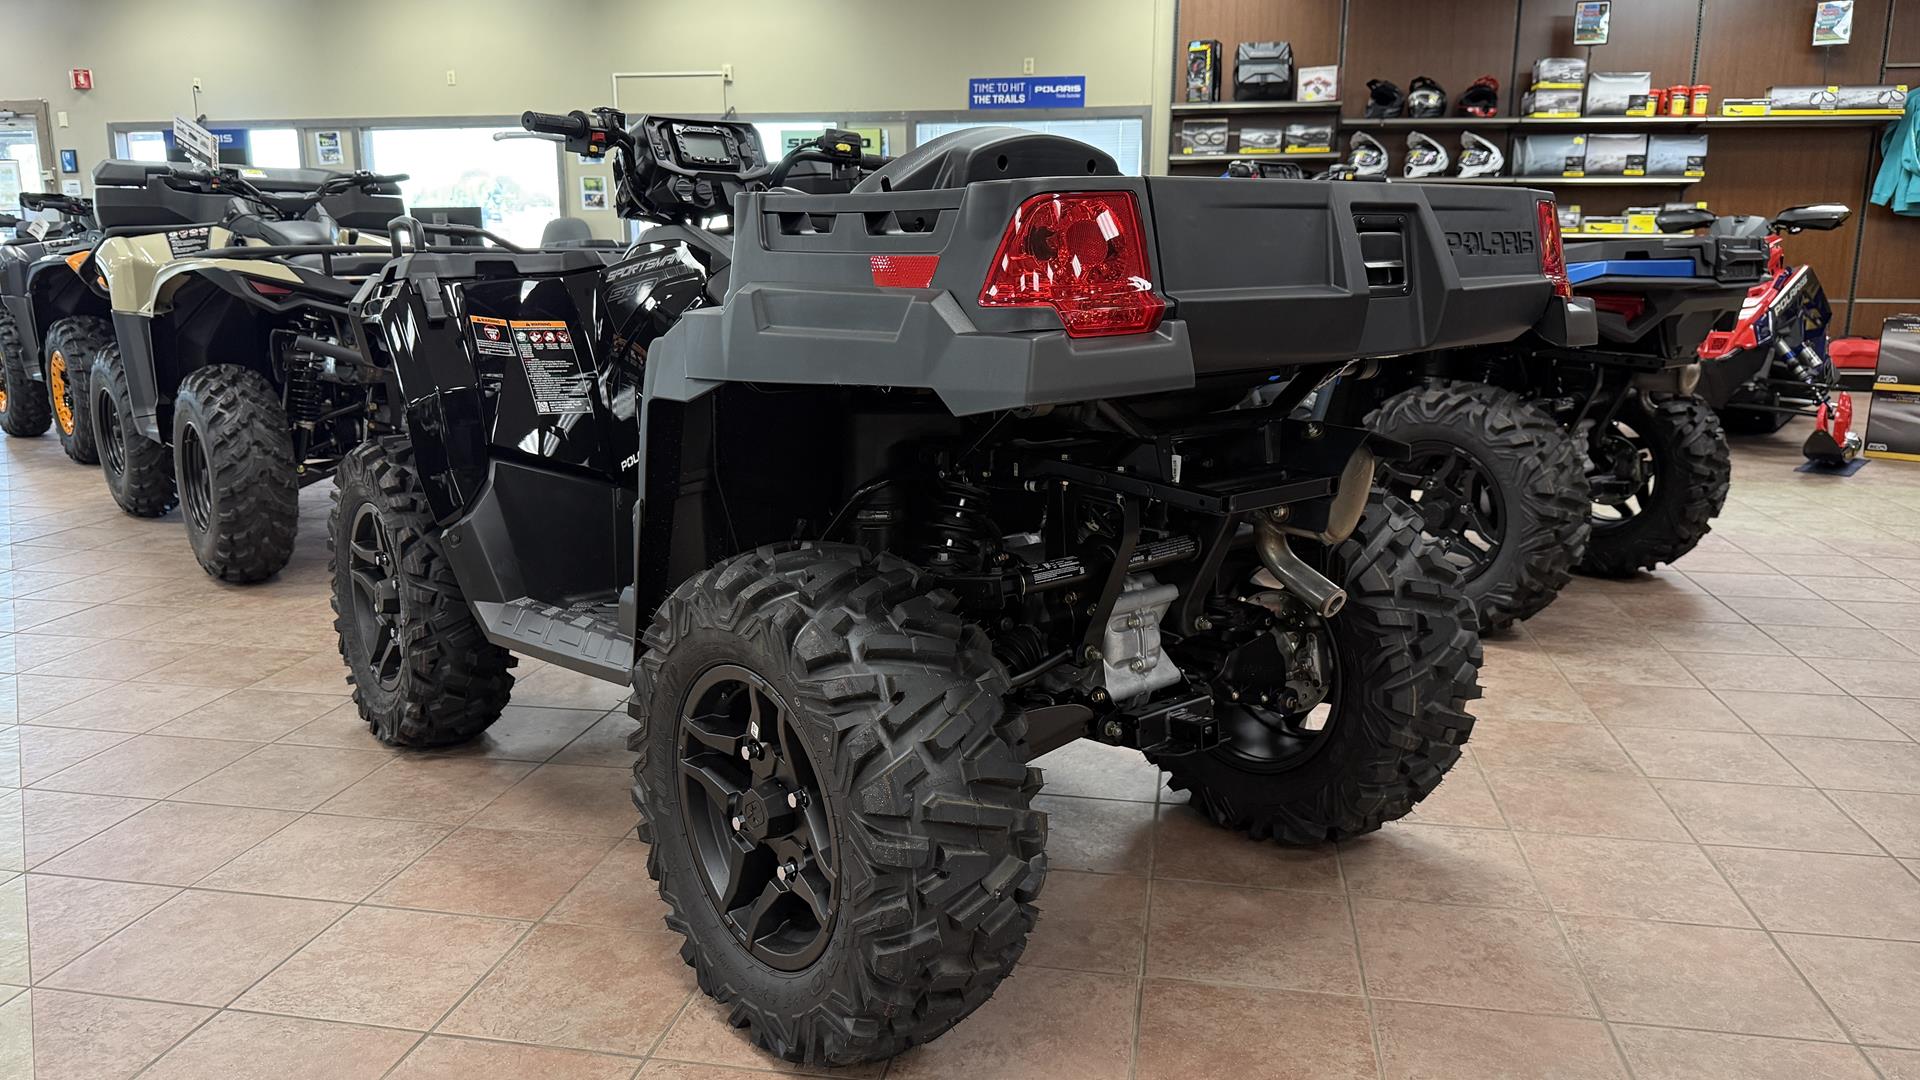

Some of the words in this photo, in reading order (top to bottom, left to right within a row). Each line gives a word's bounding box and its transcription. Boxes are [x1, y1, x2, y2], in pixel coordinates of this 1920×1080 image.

[973, 83, 995, 93] TIME
[998, 83, 1008, 93] TO
[1010, 82, 1025, 93] HIT
[1034, 84, 1082, 94] POLARIS
[973, 95, 991, 104] THE
[993, 94, 1025, 104] TRAILS
[1444, 231, 1534, 256] POLARIS
[605, 252, 683, 283] SPORTSMAN
